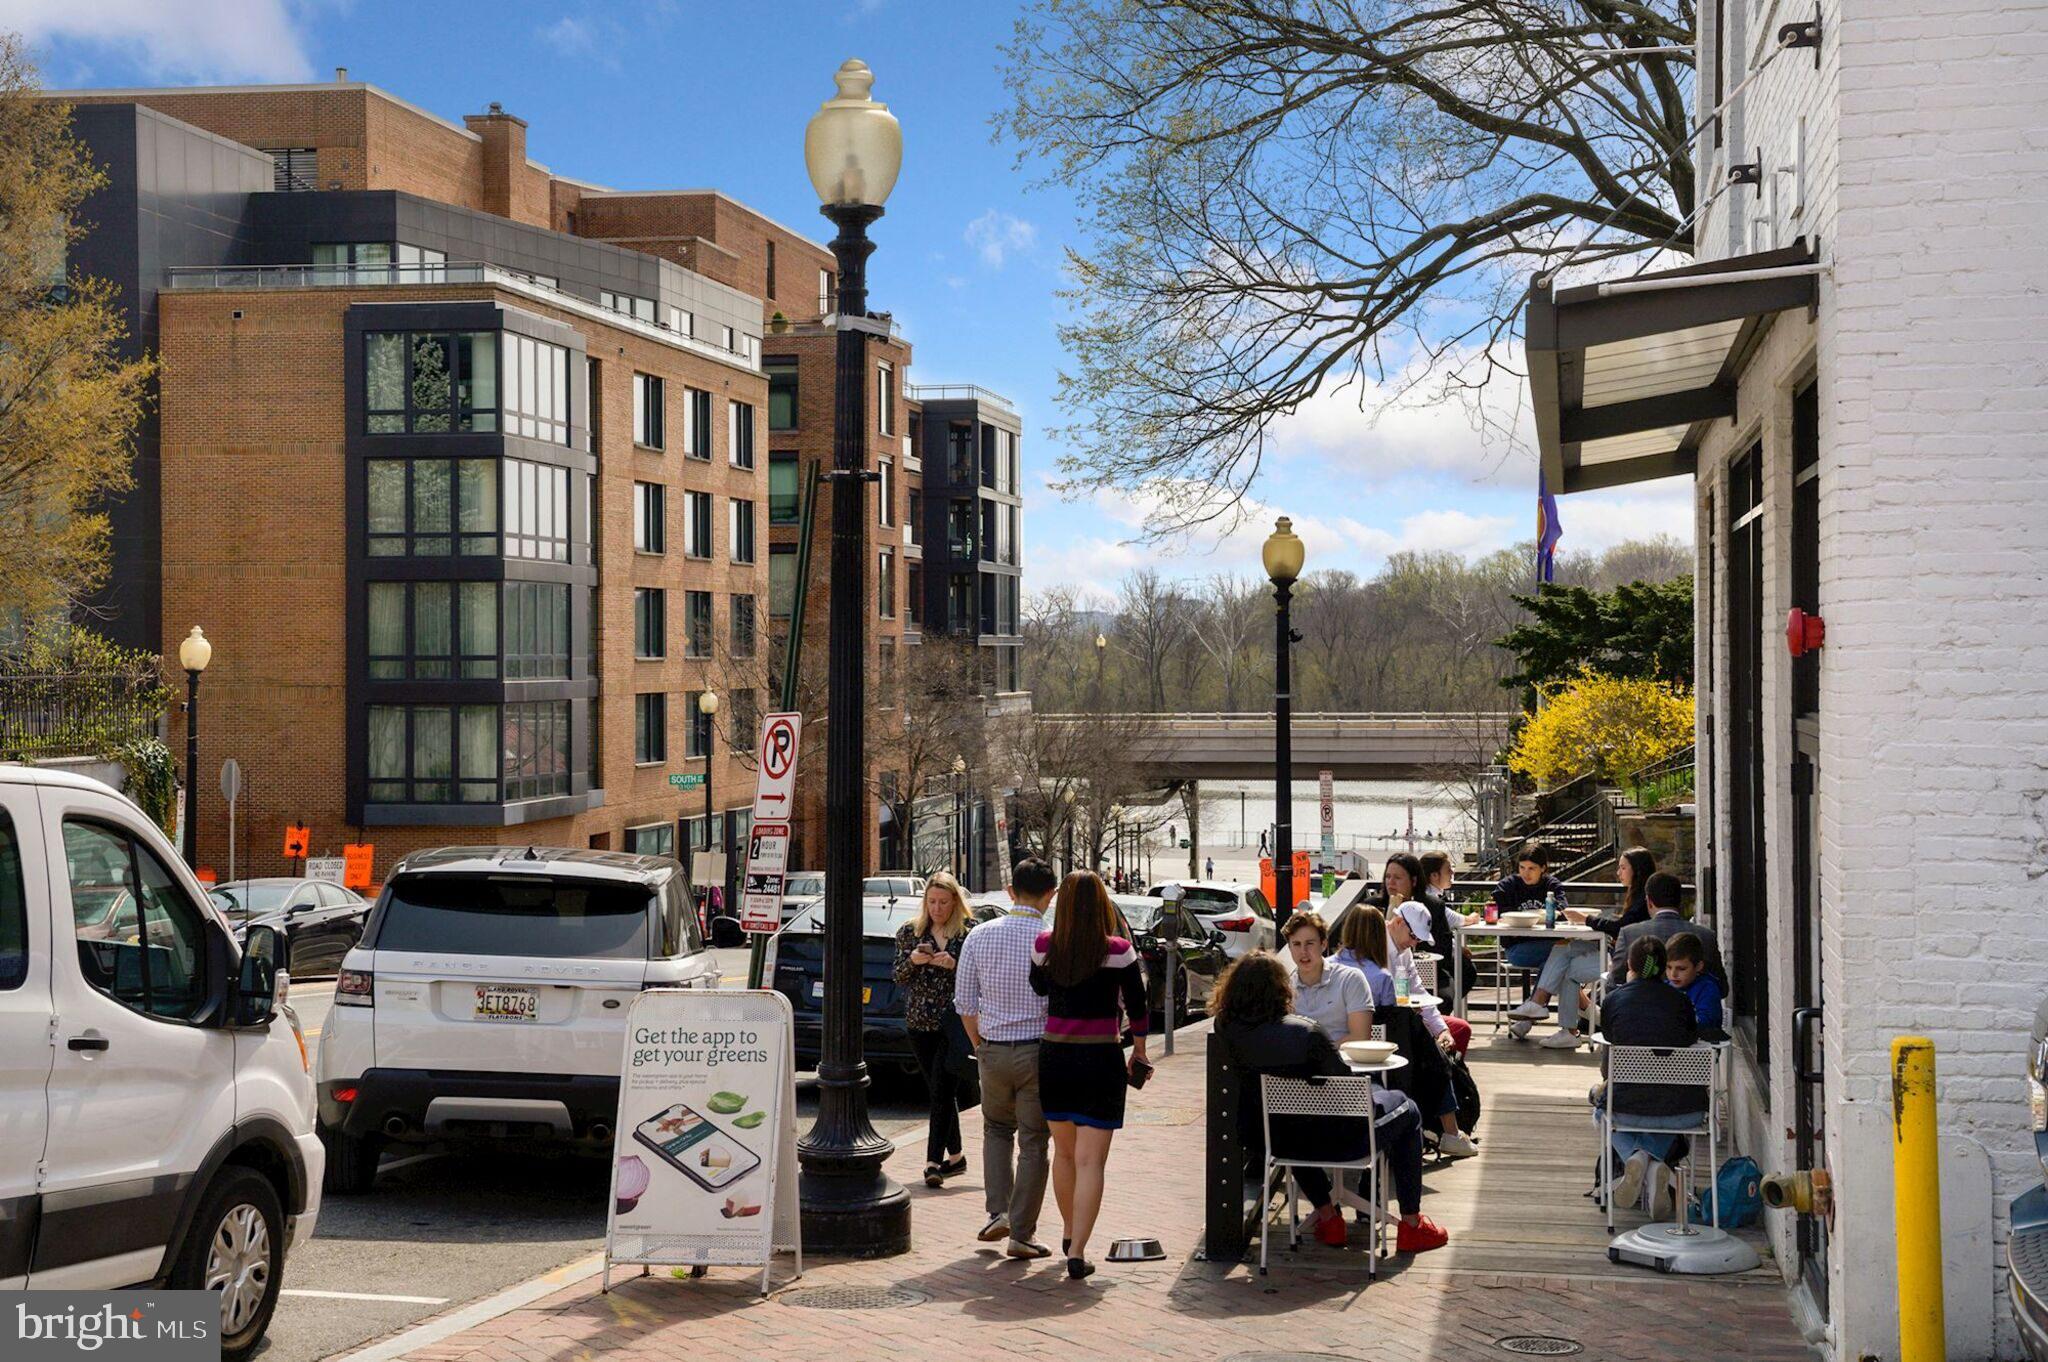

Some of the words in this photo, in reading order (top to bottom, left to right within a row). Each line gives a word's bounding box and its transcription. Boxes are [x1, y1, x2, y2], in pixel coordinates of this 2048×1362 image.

[671, 775, 697, 784] SOUTH
[773, 827, 785, 836] ZONE
[751, 838, 760, 858] 2
[761, 840, 777, 850] HOUR
[308, 861, 323, 870] ROAD
[324, 861, 343, 870] CLOSED
[523, 965, 601, 976] ROVER
[477, 994, 536, 1013] 3ET8768
[635, 1028, 667, 1044] Get
[671, 1027, 699, 1044] the
[702, 1031, 735, 1049] app
[737, 1030, 758, 1045] to
[633, 1048, 661, 1067] get
[664, 1049, 704, 1067] your
[706, 1048, 768, 1067] greens
